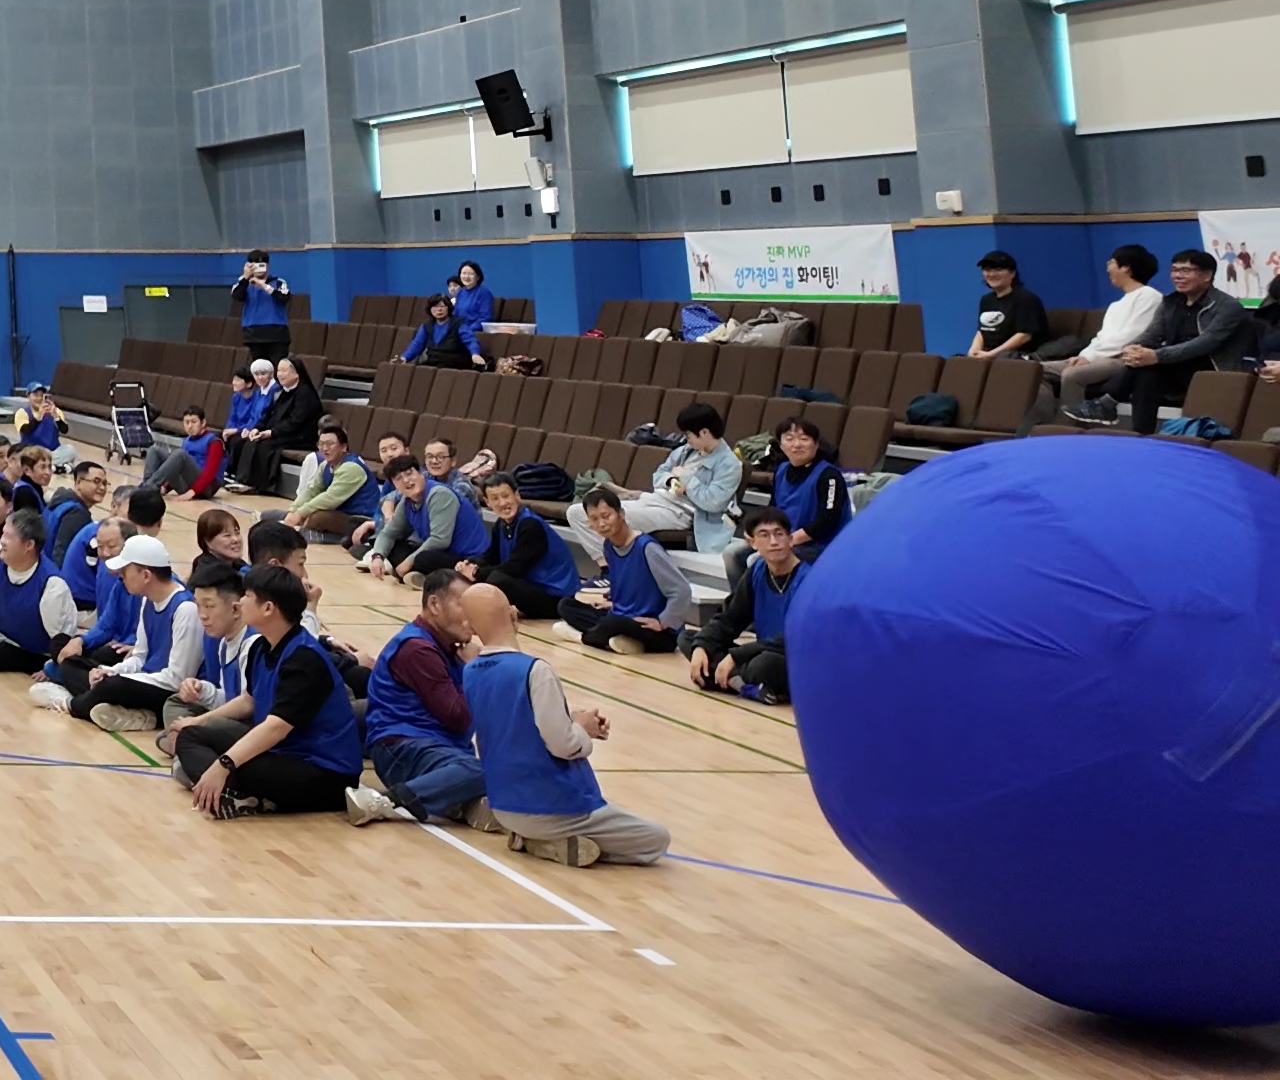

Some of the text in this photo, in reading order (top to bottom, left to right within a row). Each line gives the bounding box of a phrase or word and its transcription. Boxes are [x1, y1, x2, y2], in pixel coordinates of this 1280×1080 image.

[766, 245, 811, 263] 진짜 MVP
[734, 265, 839, 289] 성가정의 집 화이팅!
